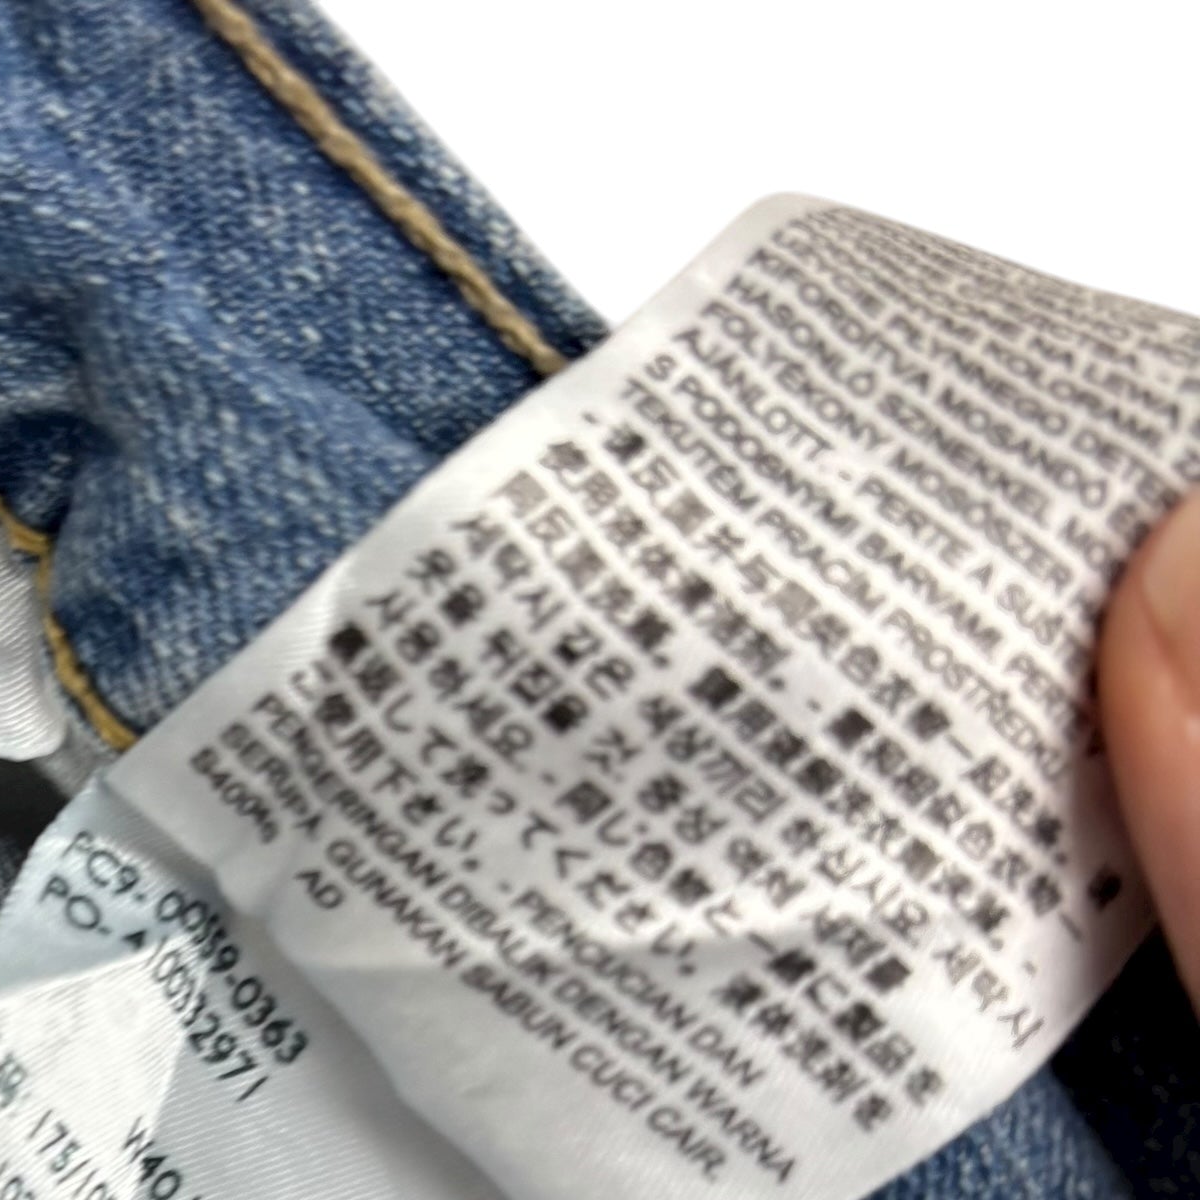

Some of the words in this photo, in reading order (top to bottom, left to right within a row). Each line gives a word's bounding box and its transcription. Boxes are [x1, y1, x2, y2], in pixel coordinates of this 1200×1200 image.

[41, 873, 112, 940] PO-
[293, 866, 347, 914] AD
[687, 1024, 766, 1089] DAN
[686, 1078, 797, 1185] WARNA
